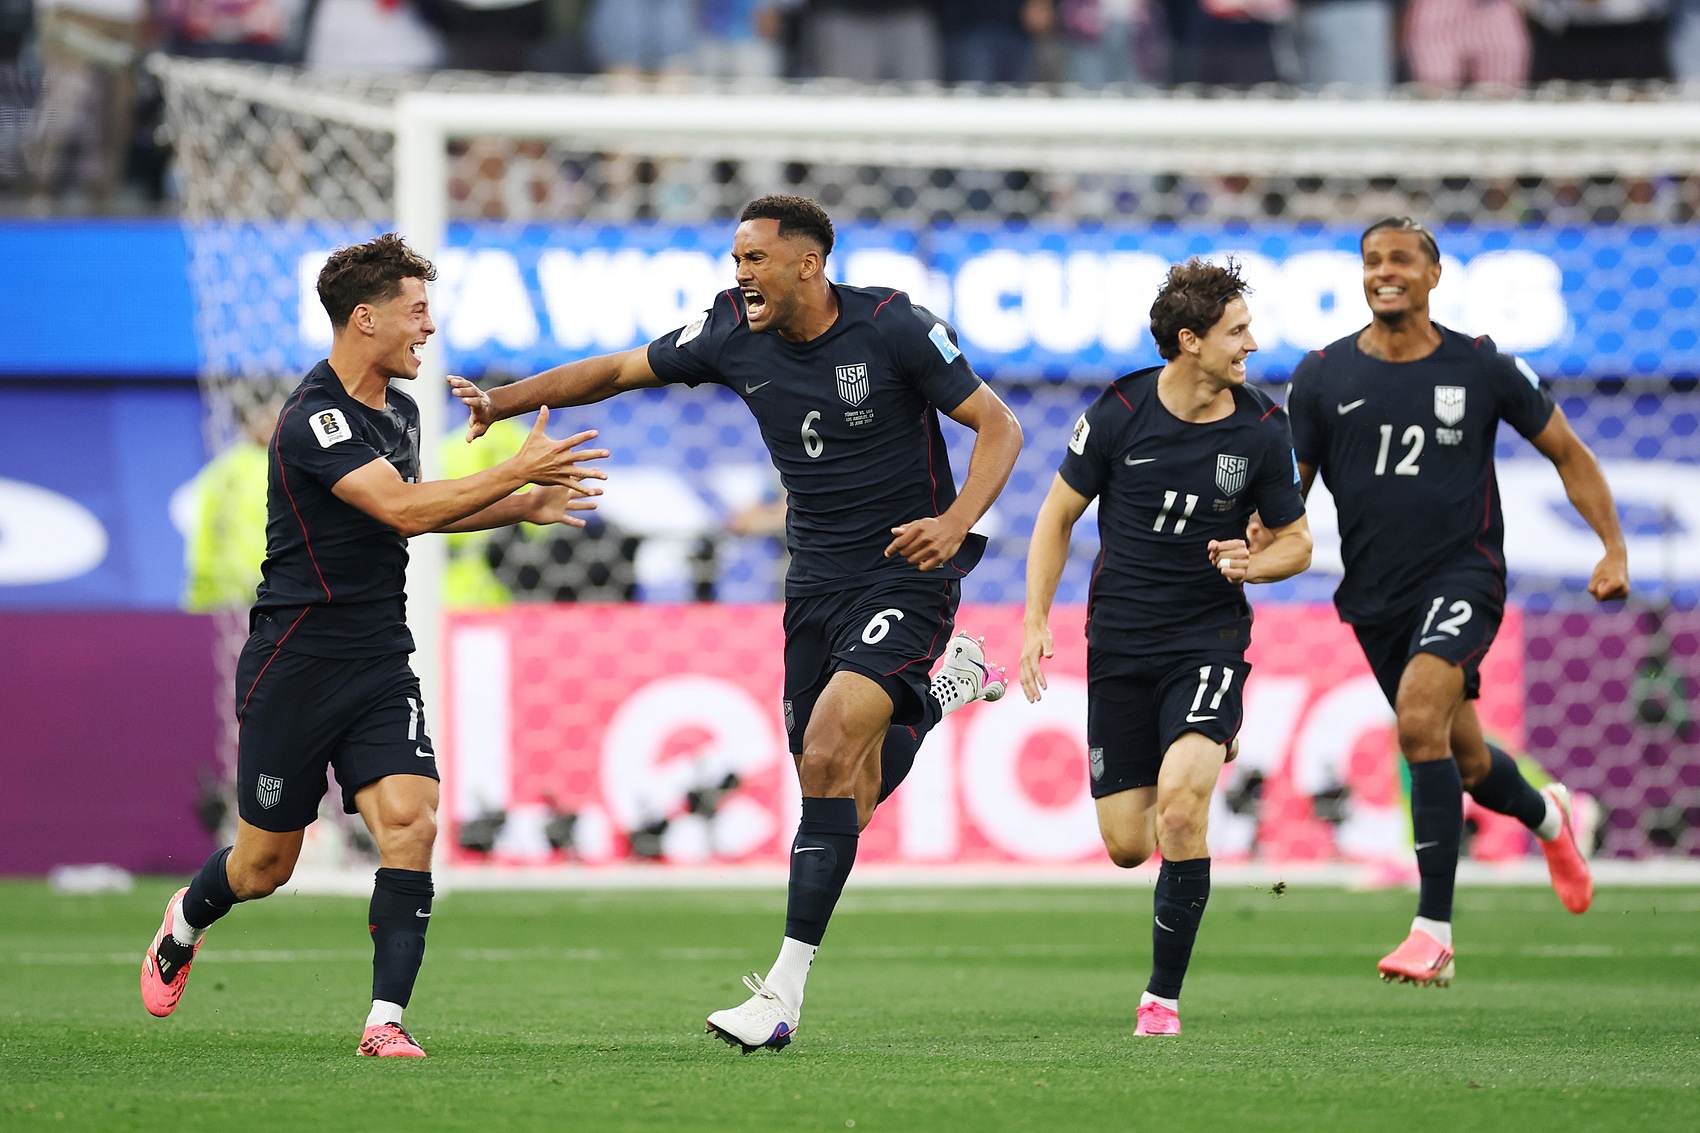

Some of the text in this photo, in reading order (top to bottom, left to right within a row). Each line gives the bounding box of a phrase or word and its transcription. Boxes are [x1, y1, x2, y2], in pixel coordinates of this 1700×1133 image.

[838, 366, 865, 383] USA
[802, 410, 823, 458] 6
[1374, 424, 1425, 476] 12
[1220, 457, 1245, 474] USA
[1153, 490, 1199, 534] 11
[862, 609, 904, 644] 6
[1421, 596, 1472, 636] 12
[1190, 666, 1234, 711] 11
[260, 776, 280, 790] USA
